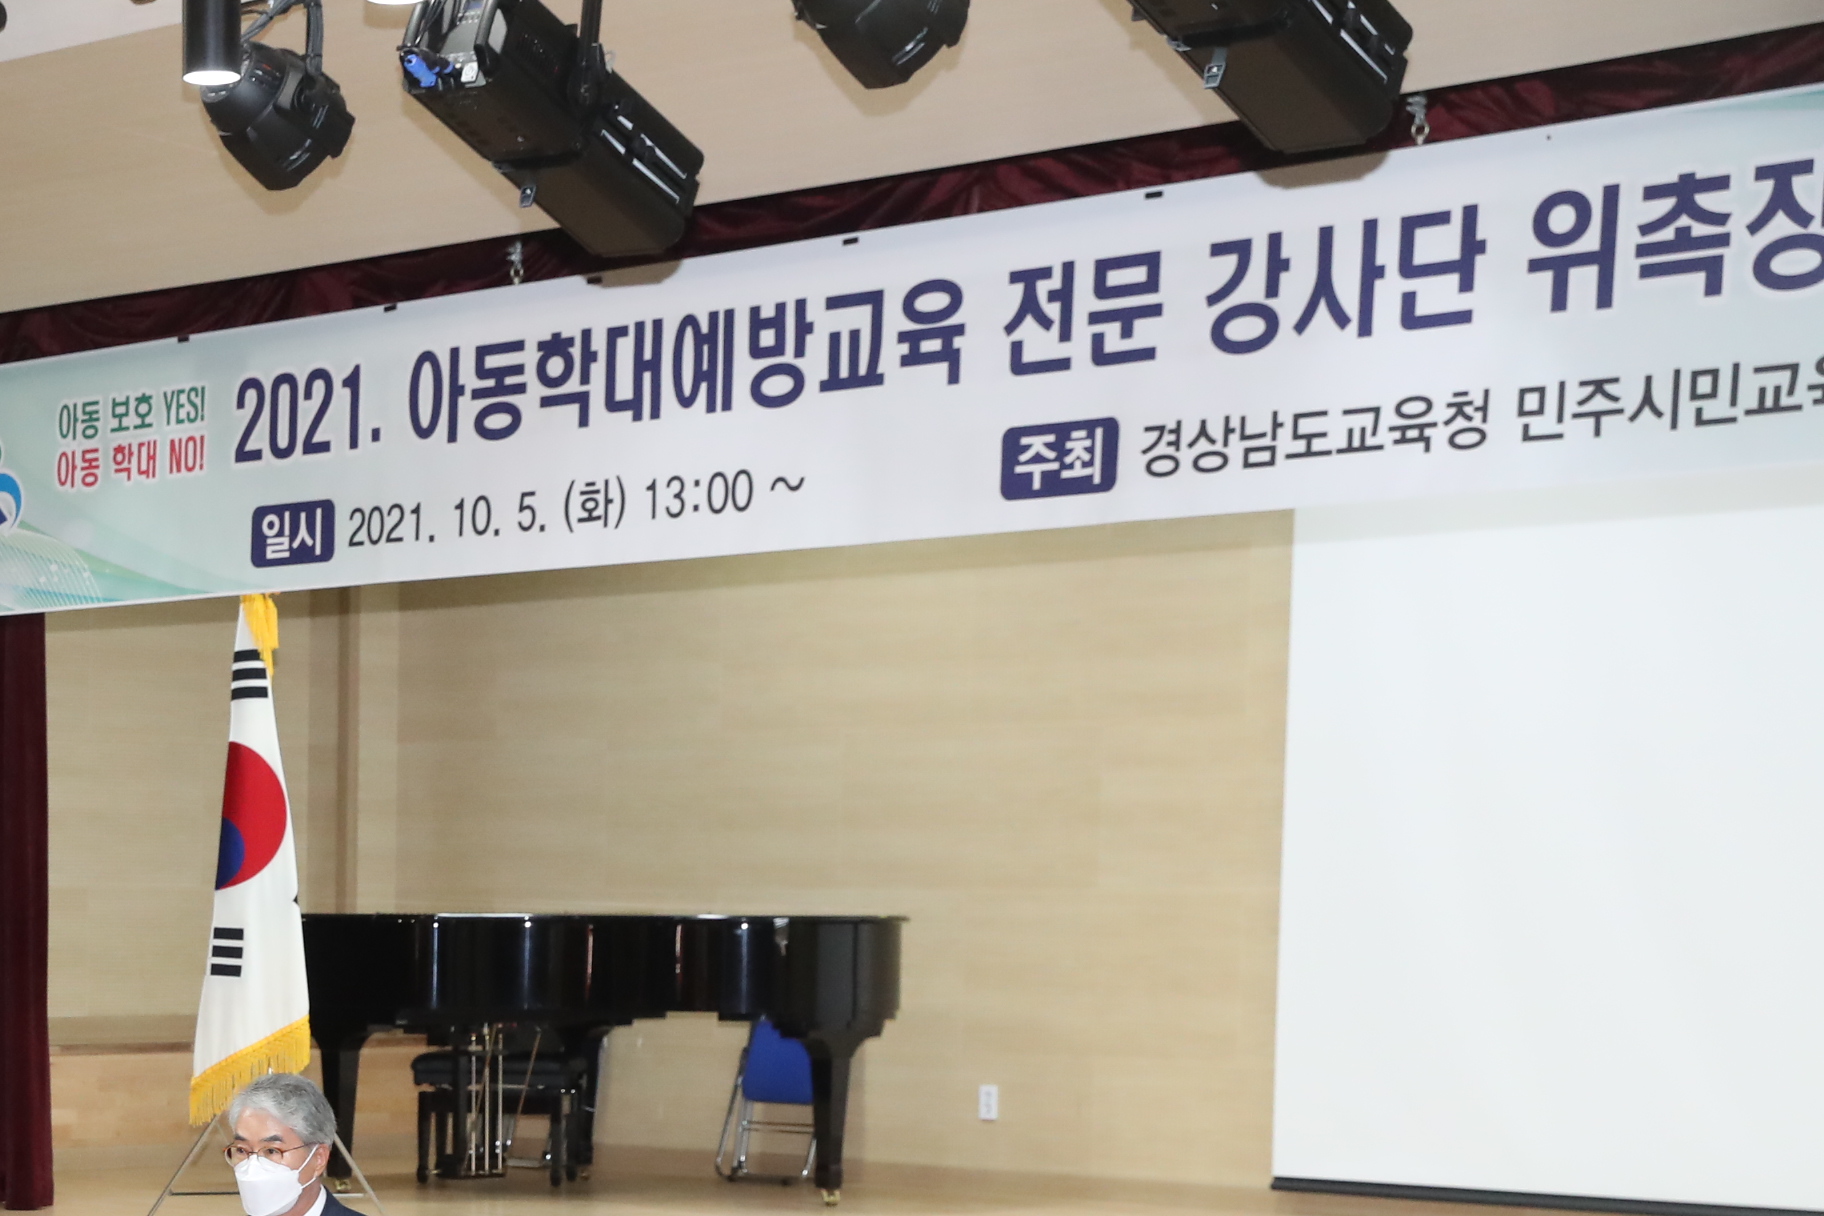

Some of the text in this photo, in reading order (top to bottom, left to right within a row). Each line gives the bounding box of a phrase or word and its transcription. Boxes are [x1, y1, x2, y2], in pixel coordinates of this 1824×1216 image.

[234, 158, 1824, 464] 2021. 아동학대예방교육 전문 강사단 위촉장
[59, 385, 206, 440] 아동 보호 YES!
[1013, 426, 1104, 491] 주최
[1141, 388, 1490, 478] 경상남도교육청
[57, 435, 205, 488] 아동 학대 NO!
[261, 507, 323, 560] 일시
[348, 502, 435, 548] 2021.
[454, 494, 500, 537] 10.
[516, 490, 546, 533] 5.
[564, 475, 626, 533] (화)
